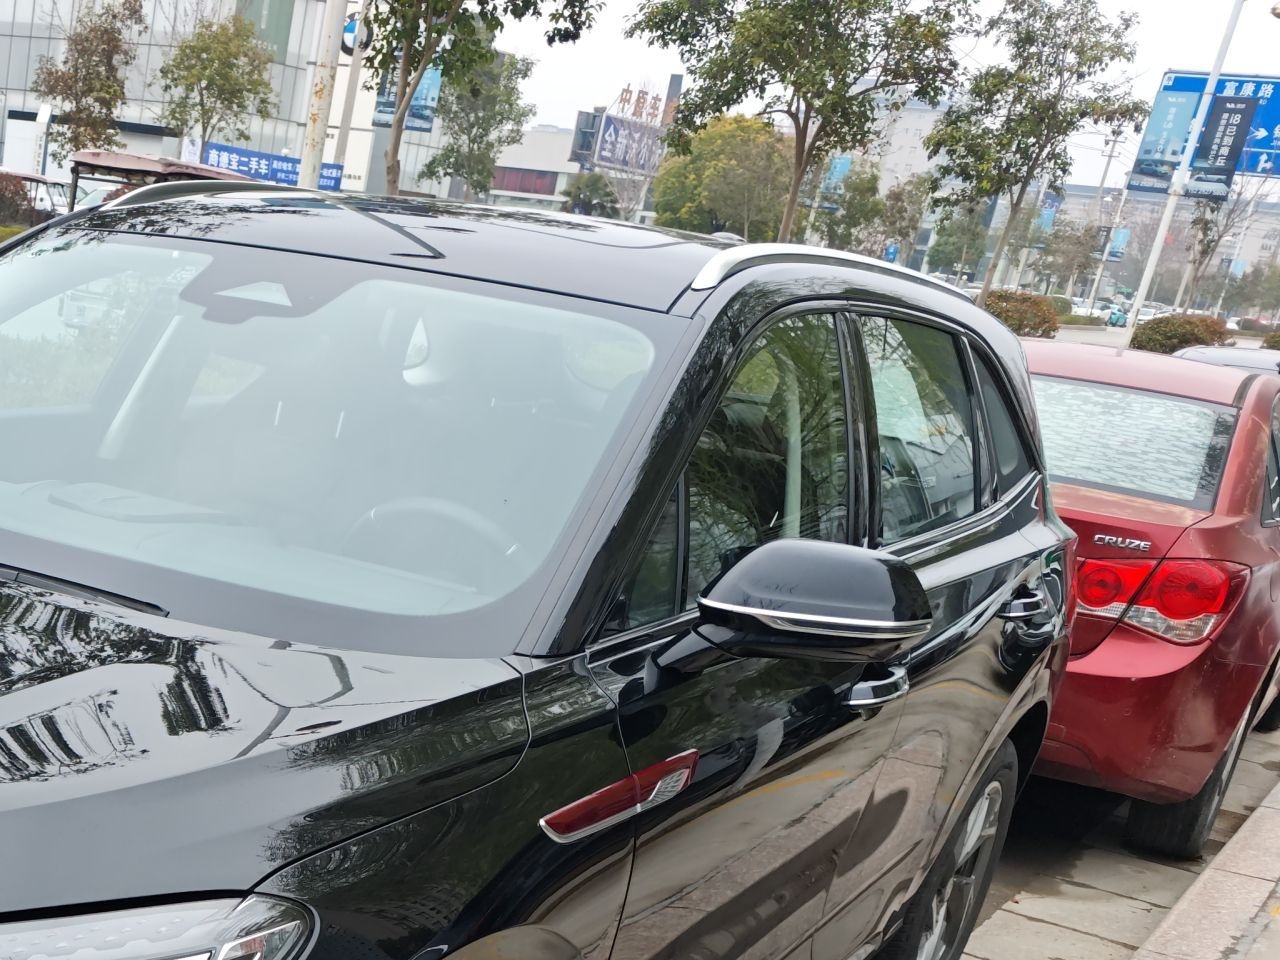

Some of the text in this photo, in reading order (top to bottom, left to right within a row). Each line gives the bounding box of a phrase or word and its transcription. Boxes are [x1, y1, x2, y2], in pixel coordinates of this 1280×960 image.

[1222, 81, 1275, 98] 富康路
[208, 149, 269, 175] 商德宝二手车
[1093, 534, 1152, 552] CRUZE
